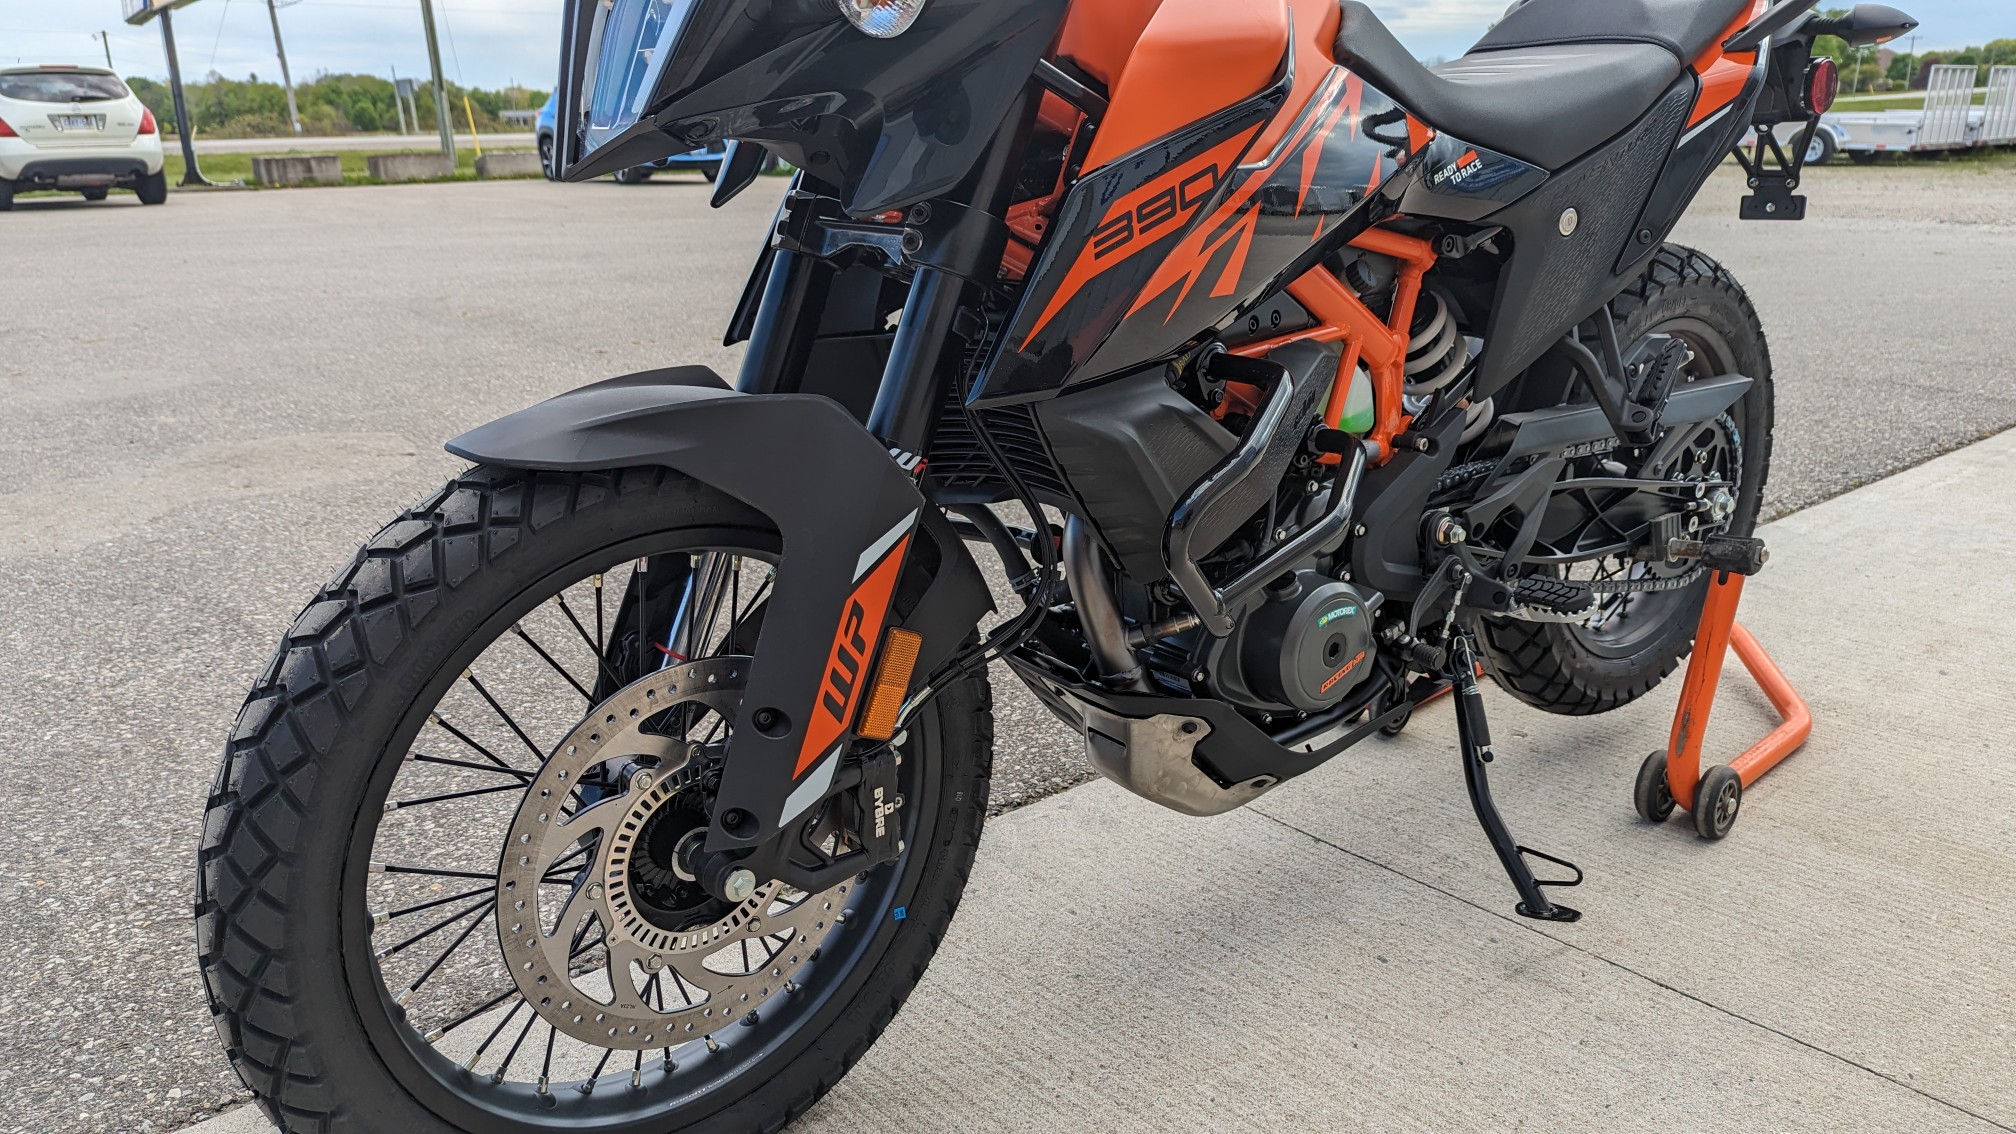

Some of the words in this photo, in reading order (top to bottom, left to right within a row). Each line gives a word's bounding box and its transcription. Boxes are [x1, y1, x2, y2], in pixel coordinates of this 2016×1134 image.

[1433, 161, 1457, 185] READY
[1450, 171, 1462, 185] TO
[1460, 158, 1483, 179] RACE
[1092, 162, 1219, 261] 390
[1328, 606, 1355, 621] MOTOREX
[874, 786, 885, 838] BYBRE
